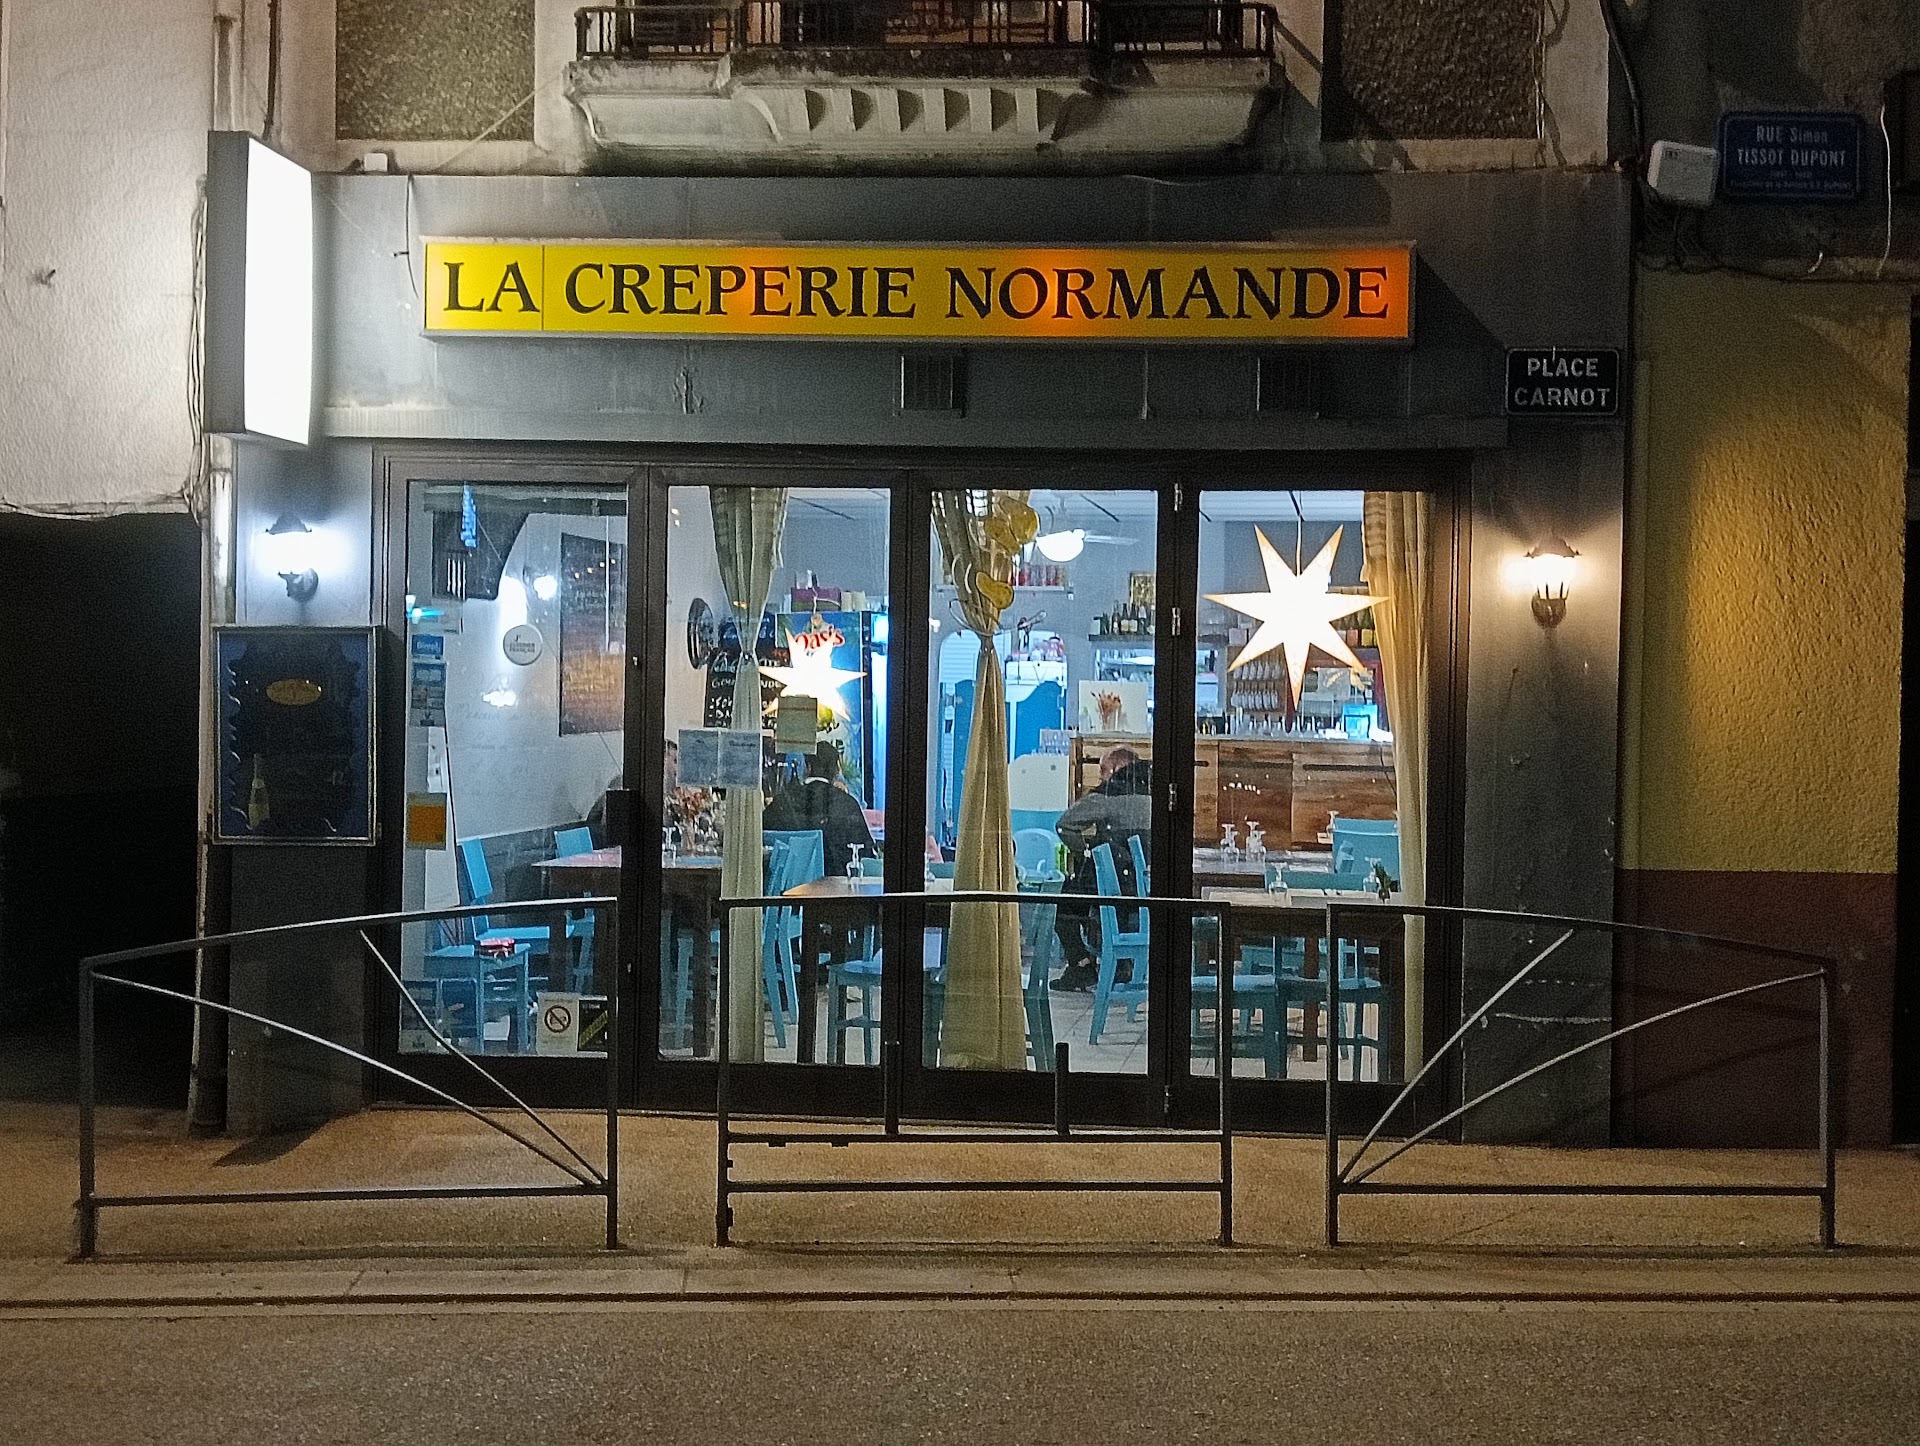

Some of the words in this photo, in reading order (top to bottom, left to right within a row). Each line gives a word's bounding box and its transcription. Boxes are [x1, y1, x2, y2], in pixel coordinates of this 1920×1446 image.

[1756, 124, 1784, 144] RUE
[1789, 125, 1829, 145] Simon
[1737, 147, 1785, 166] TISSOT
[1790, 149, 1847, 167] DUPONT
[443, 260, 541, 313] LA
[564, 262, 917, 318] CREPERIE
[945, 266, 1390, 321] NORMANDE
[1527, 357, 1599, 377] PLACE
[1514, 387, 1610, 407] CARNOT
